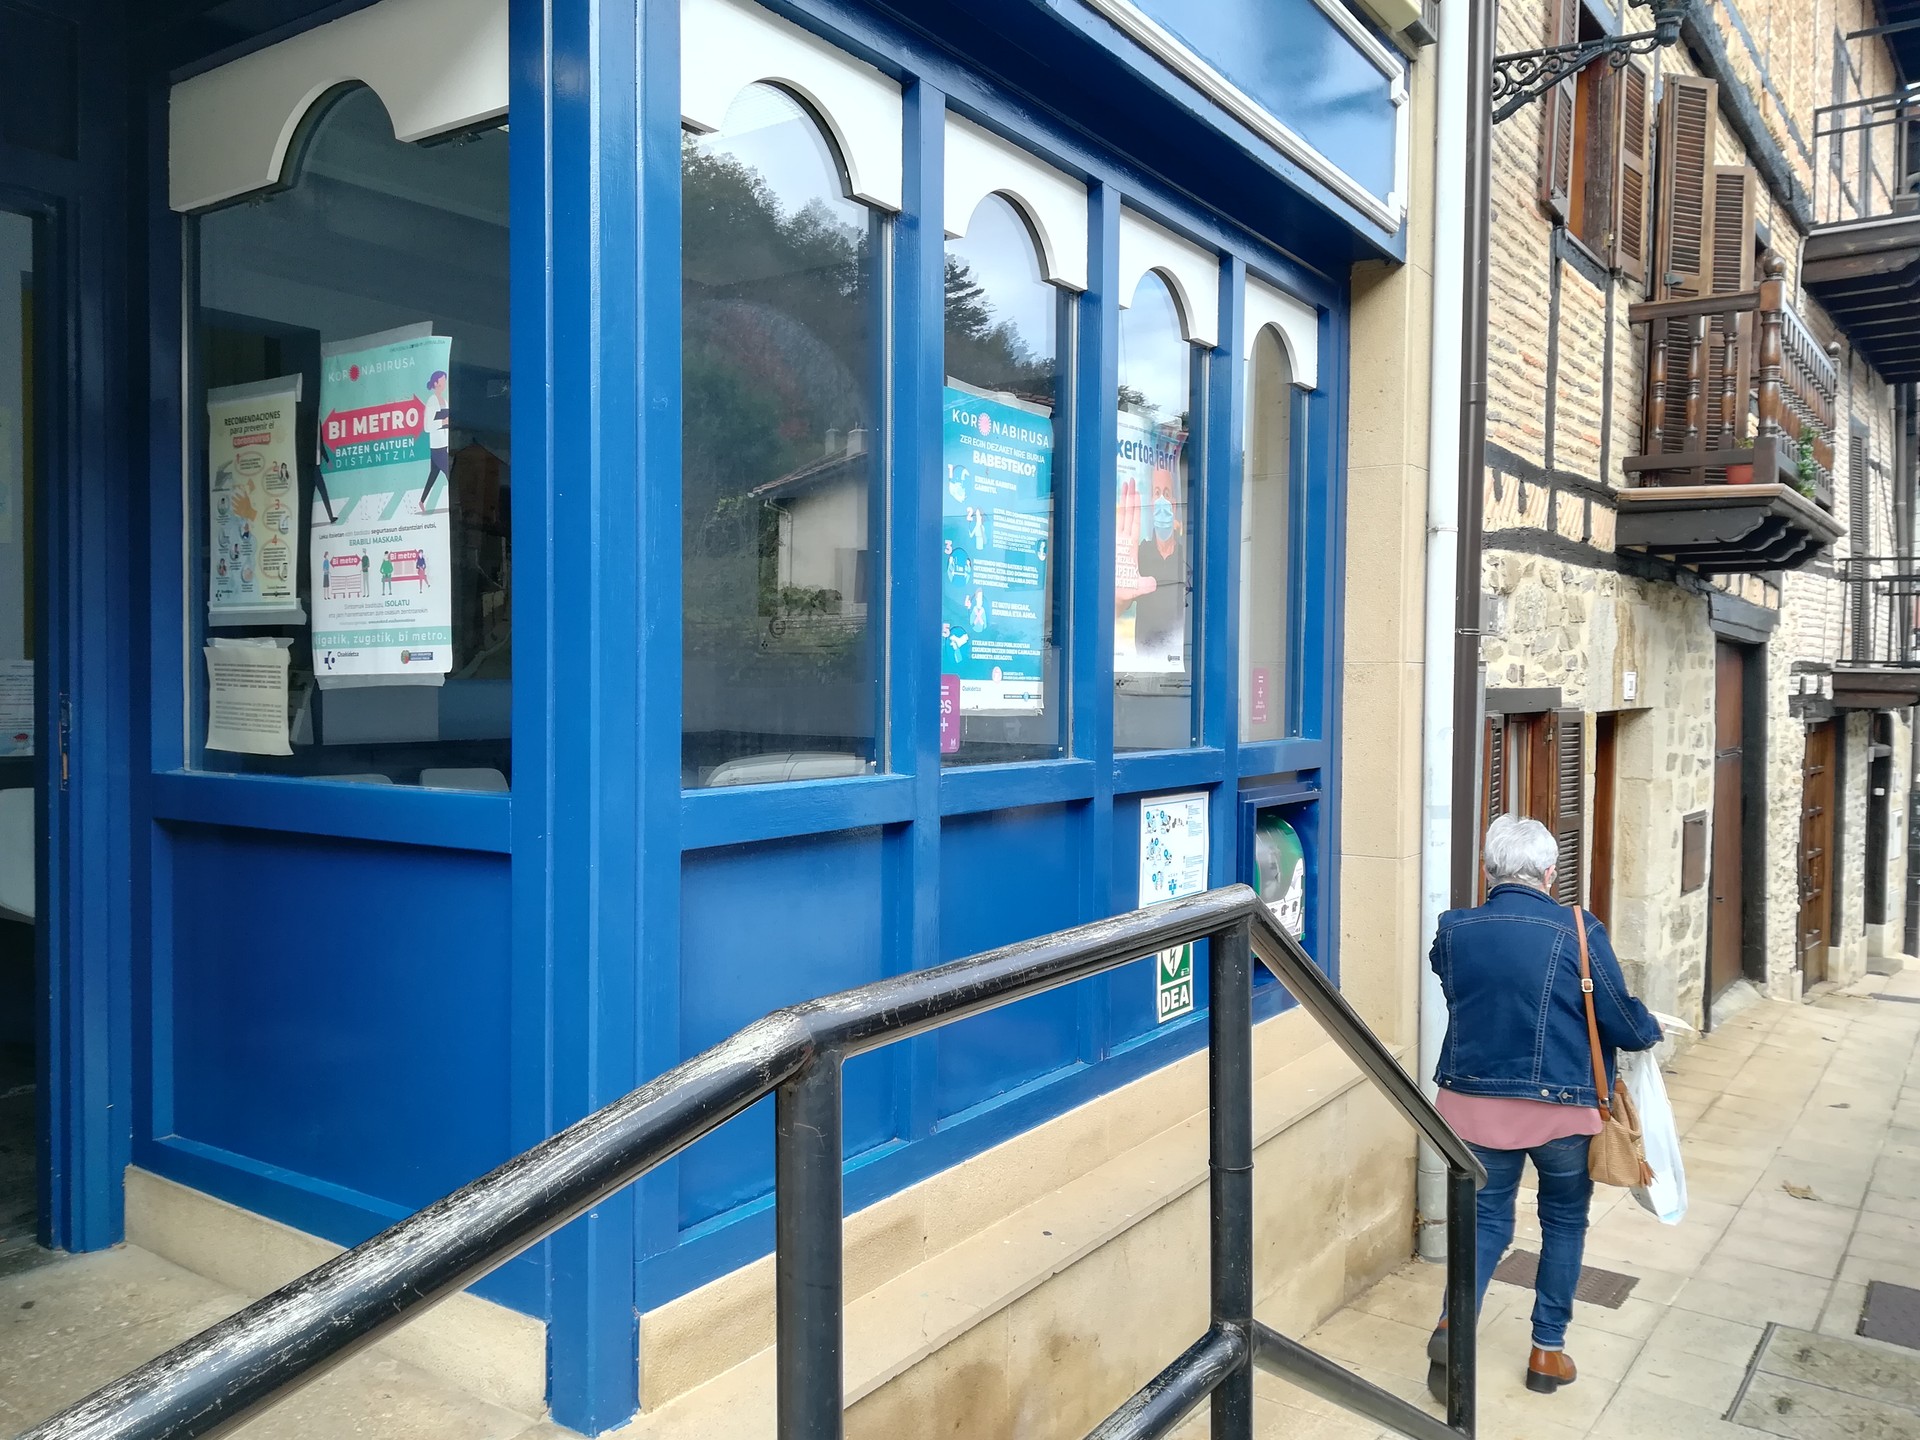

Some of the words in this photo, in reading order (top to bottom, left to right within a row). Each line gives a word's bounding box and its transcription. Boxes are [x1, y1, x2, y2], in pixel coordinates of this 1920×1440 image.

[224, 411, 281, 426] RECOMENDACIONES
[328, 420, 346, 440] BI
[353, 407, 419, 436] METRO
[230, 426, 242, 436] para
[244, 422, 268, 434] prevenir
[335, 445, 370, 458] BATZEN
[373, 438, 415, 452] GAITUEN
[960, 434, 972, 446] ZER
[987, 441, 1013, 456] DEZAKET
[335, 449, 415, 468] DISTANTZIA
[973, 450, 1037, 477] BABESTEKO?
[1155, 443, 1177, 473] jarri
[966, 506, 974, 521] 2
[349, 538, 371, 547] ERABILI
[373, 535, 403, 545] MASKARA
[944, 539, 953, 555] 3
[340, 557, 358, 565] metro
[398, 551, 417, 559] metro
[384, 599, 410, 607] ISOLATU
[354, 632, 395, 645] zugatik,
[398, 631, 408, 641] bi
[412, 631, 447, 641] metro.
[942, 622, 950, 638] 5
[1161, 984, 1190, 1014] DEA
